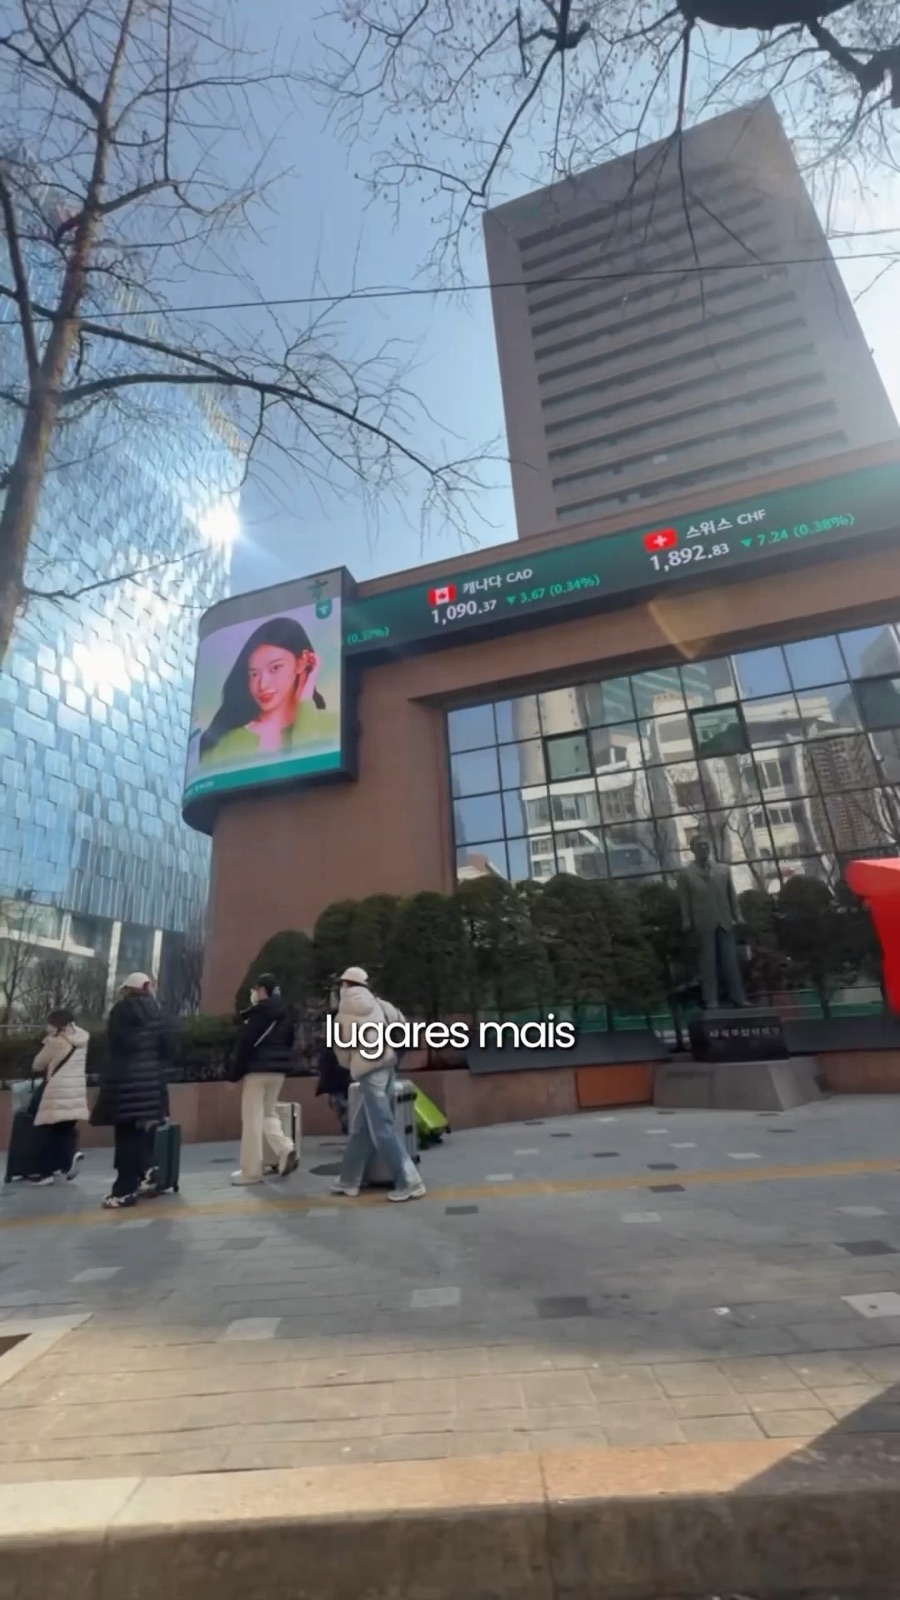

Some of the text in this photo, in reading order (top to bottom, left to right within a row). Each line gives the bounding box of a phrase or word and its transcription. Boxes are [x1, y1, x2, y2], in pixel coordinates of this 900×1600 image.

[685, 509, 767, 540] 스위스 CHF
[757, 512, 856, 546] 7.24 (0.38%)
[649, 543, 730, 572] 1,892.83
[462, 568, 533, 595] 캐나다 CAD
[520, 574, 600, 604] 3.67 (0.34%)
[431, 599, 497, 626] 1,090.37
